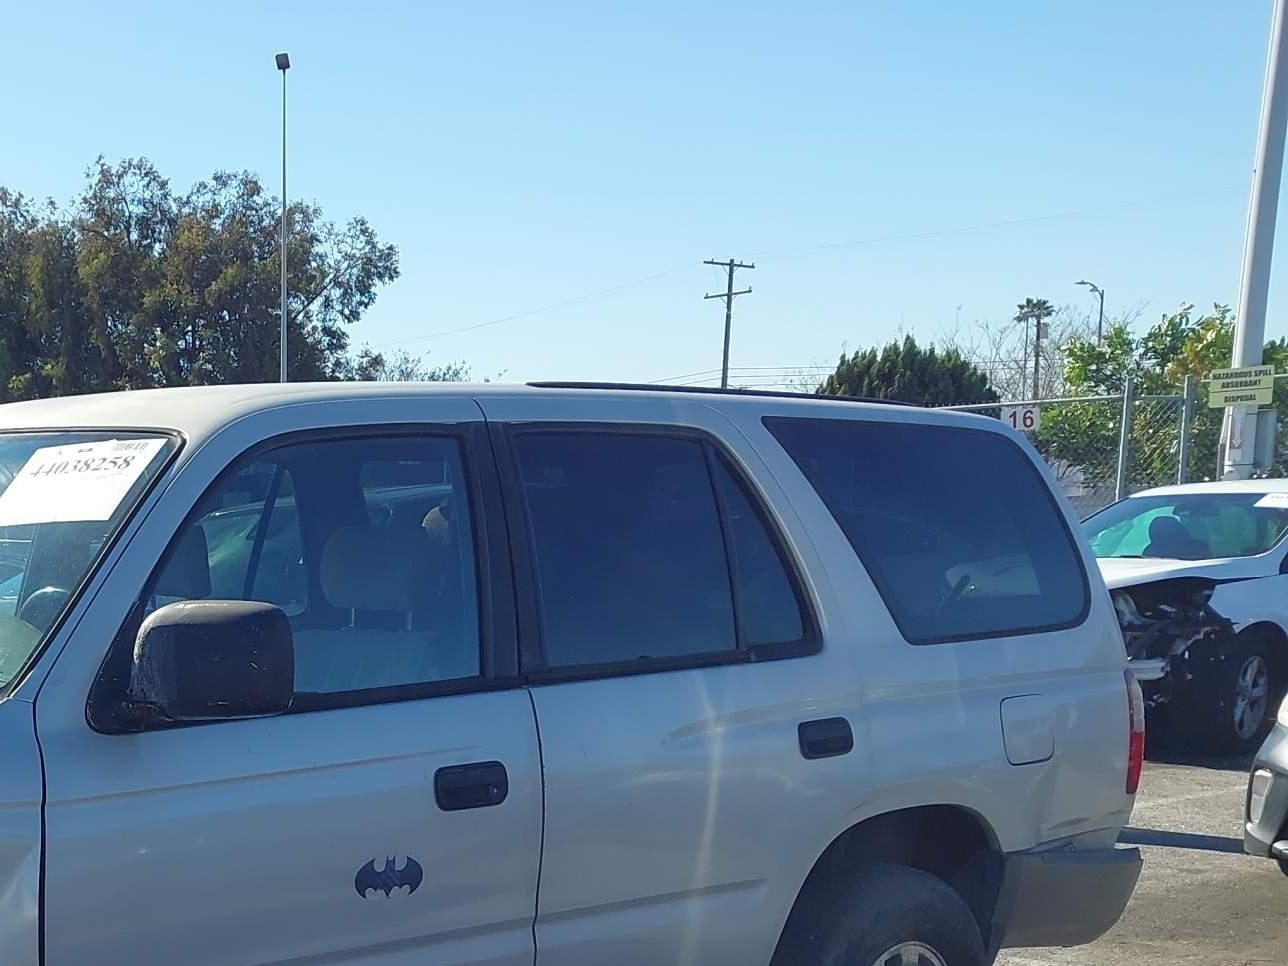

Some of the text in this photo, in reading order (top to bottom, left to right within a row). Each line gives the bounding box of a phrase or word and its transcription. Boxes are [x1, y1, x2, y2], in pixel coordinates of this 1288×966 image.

[1213, 368, 1272, 380] HAZARDOUS SPILL
[1224, 394, 1256, 402] DISPOSAL
[1009, 410, 1034, 428] 16
[30, 456, 136, 477] 44038258
